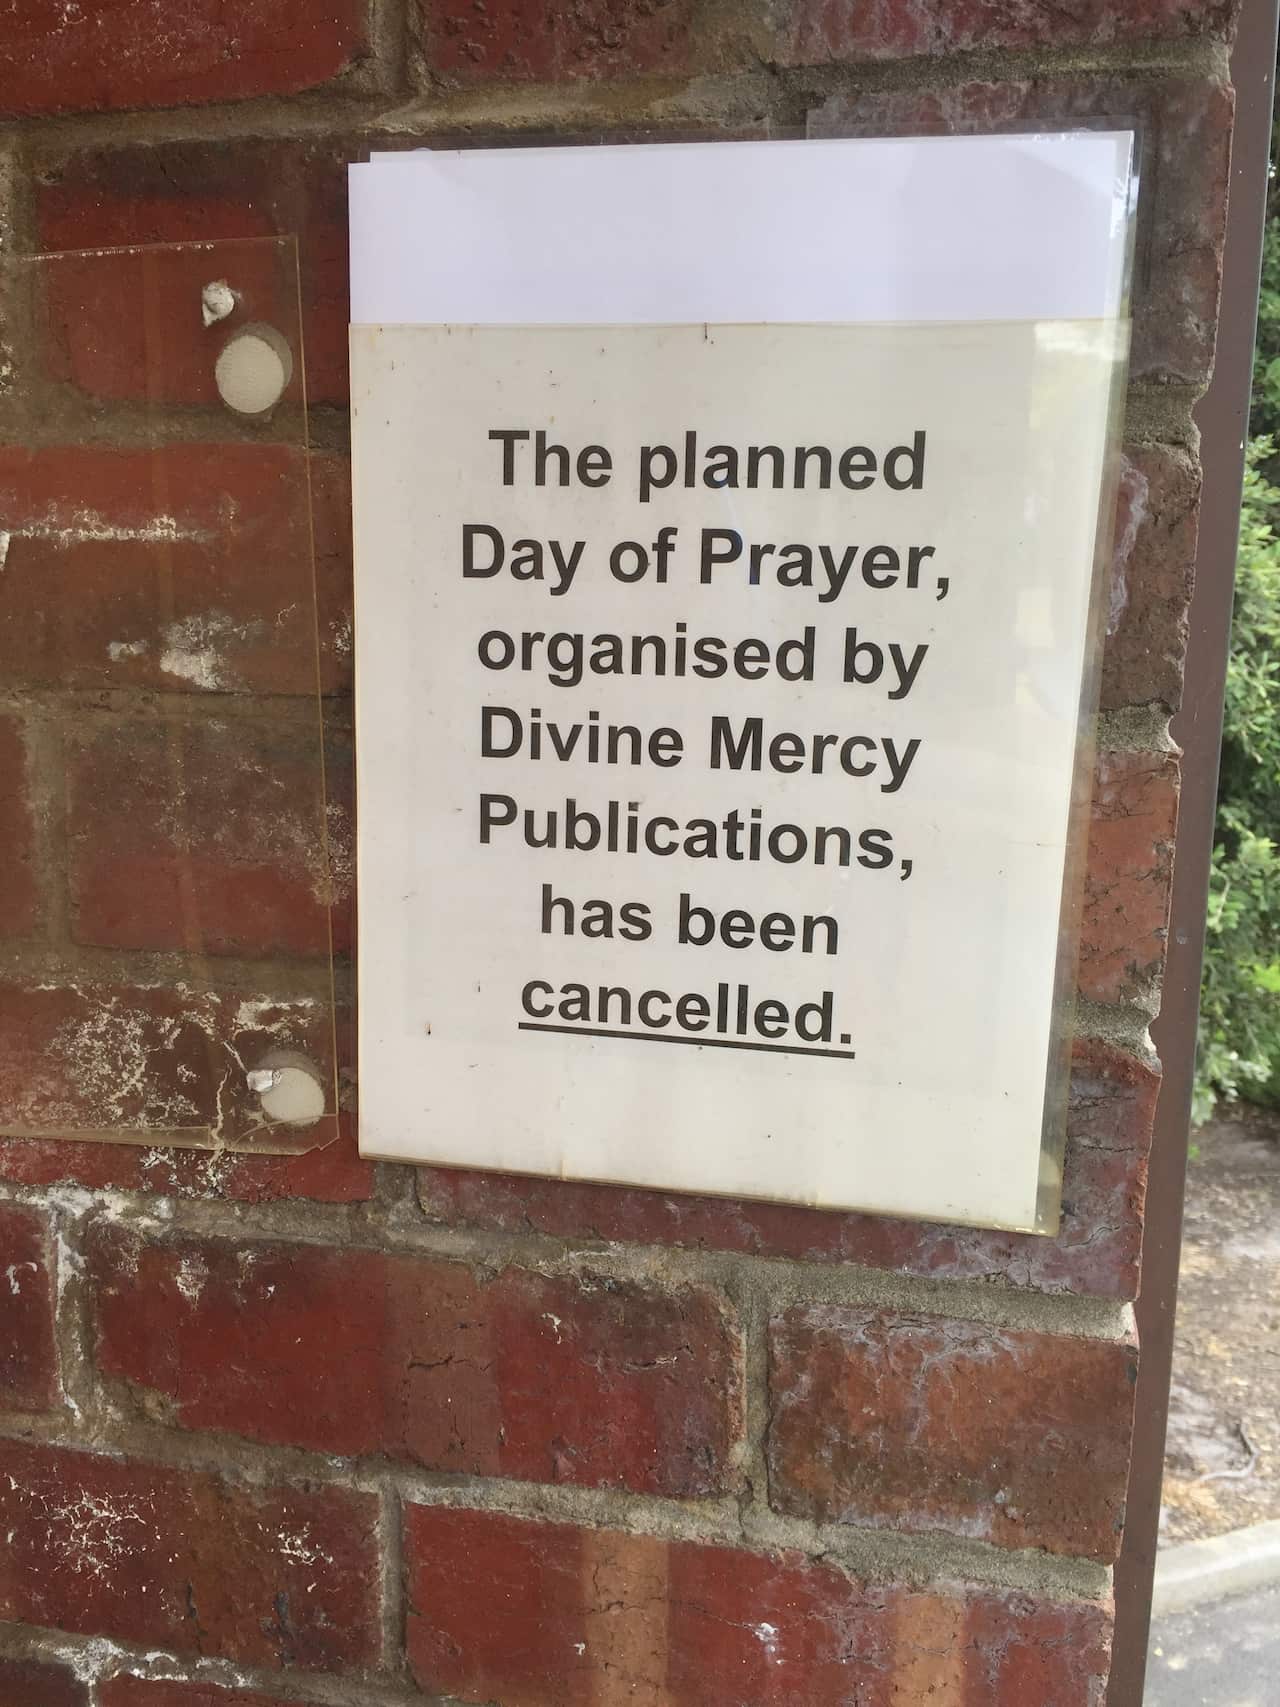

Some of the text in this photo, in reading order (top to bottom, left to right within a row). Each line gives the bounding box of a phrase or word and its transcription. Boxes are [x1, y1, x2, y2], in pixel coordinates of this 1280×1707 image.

[488, 429, 926, 503] The planned
[462, 523, 950, 601] Day of Prayer,
[477, 622, 929, 701] organised by
[481, 705, 922, 794] Divine Mercy
[479, 793, 913, 881] Publications,
[541, 883, 839, 955] has been
[521, 980, 852, 1046] cancelled.
